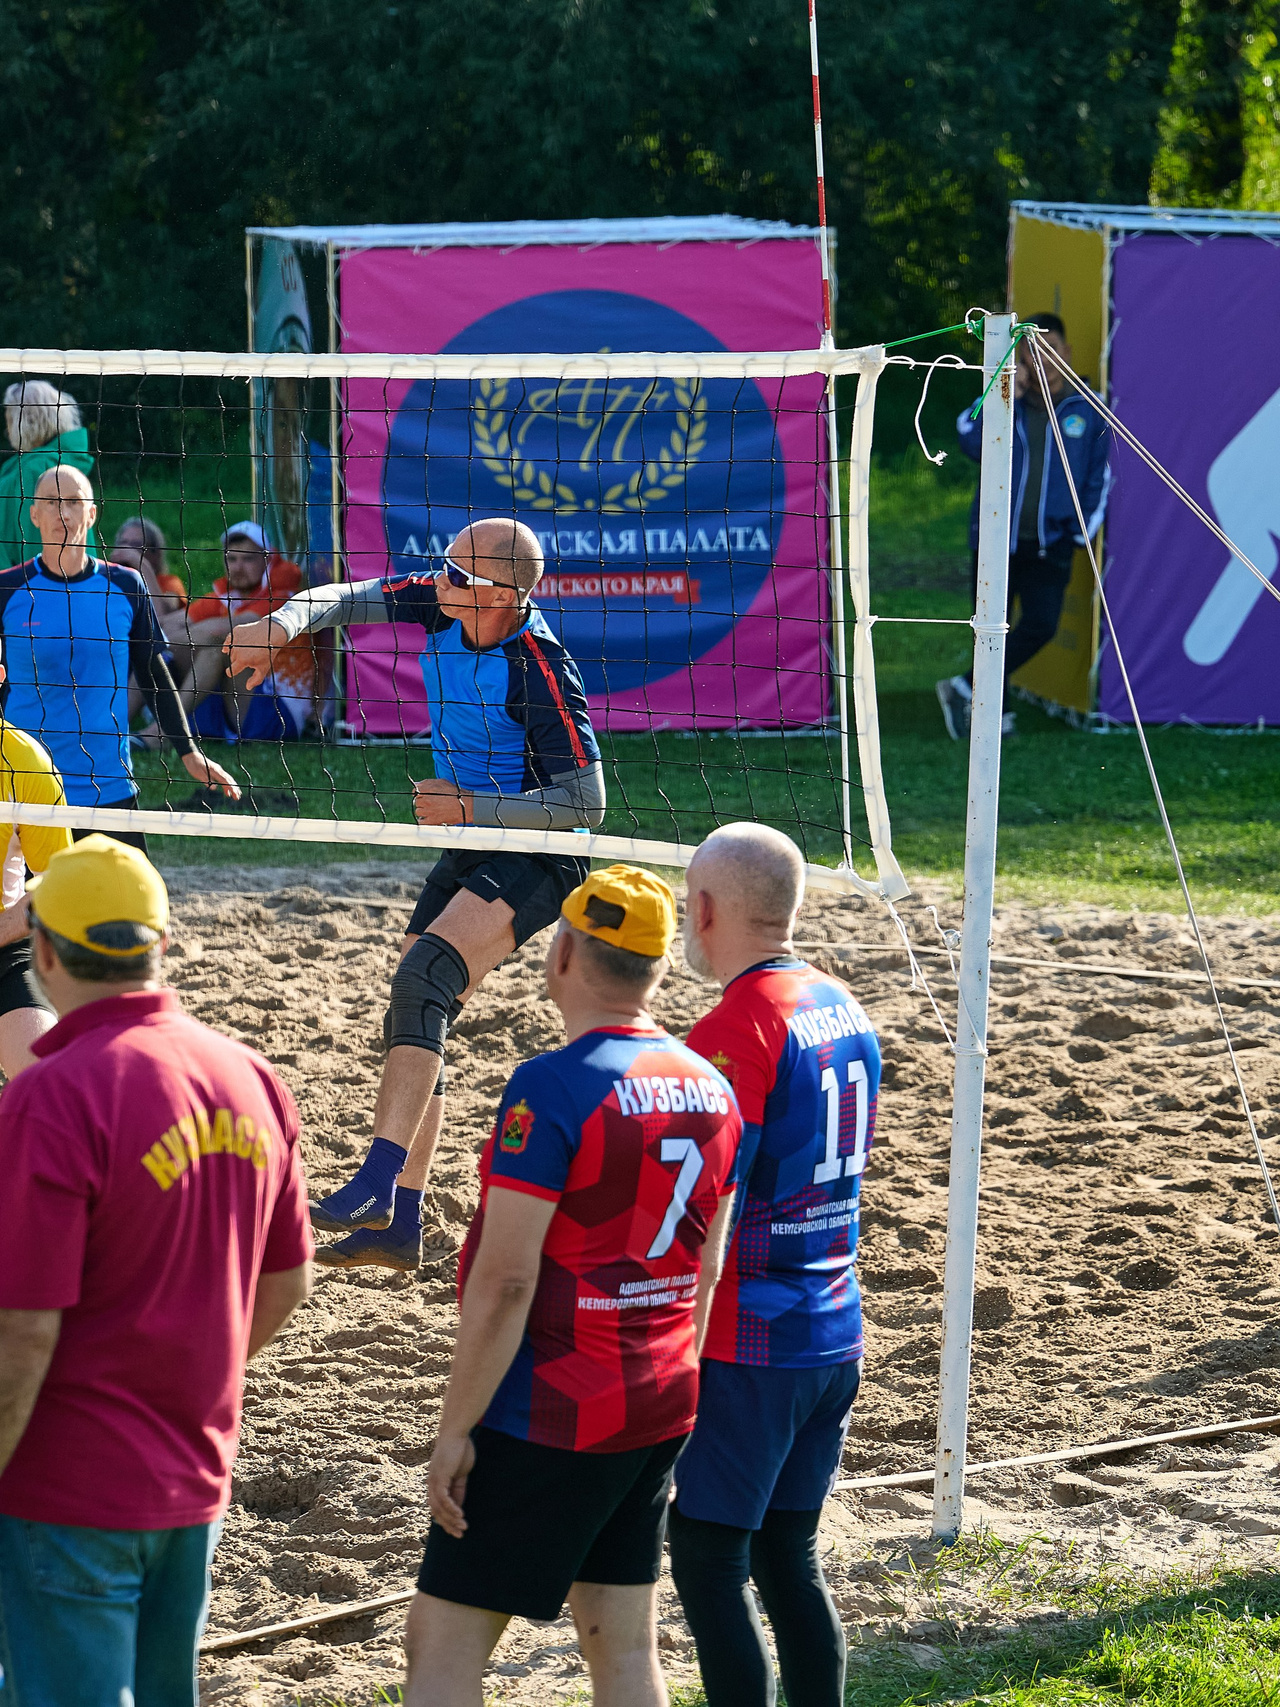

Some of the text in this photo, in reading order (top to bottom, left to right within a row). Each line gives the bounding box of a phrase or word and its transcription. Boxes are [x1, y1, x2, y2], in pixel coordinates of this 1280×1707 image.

[401, 527, 770, 562] АДТСКАЯ ПАЛАТА
[533, 575, 684, 596] ЙСКОГО КРАЯ
[612, 1076, 729, 1117] КУЗБАСС
[813, 1059, 869, 1186] 11
[350, 1195, 377, 1220] REBORN
[646, 1138, 705, 1260] 7
[771, 1216, 827, 1235] КЕМЕРОВСКОЙ
